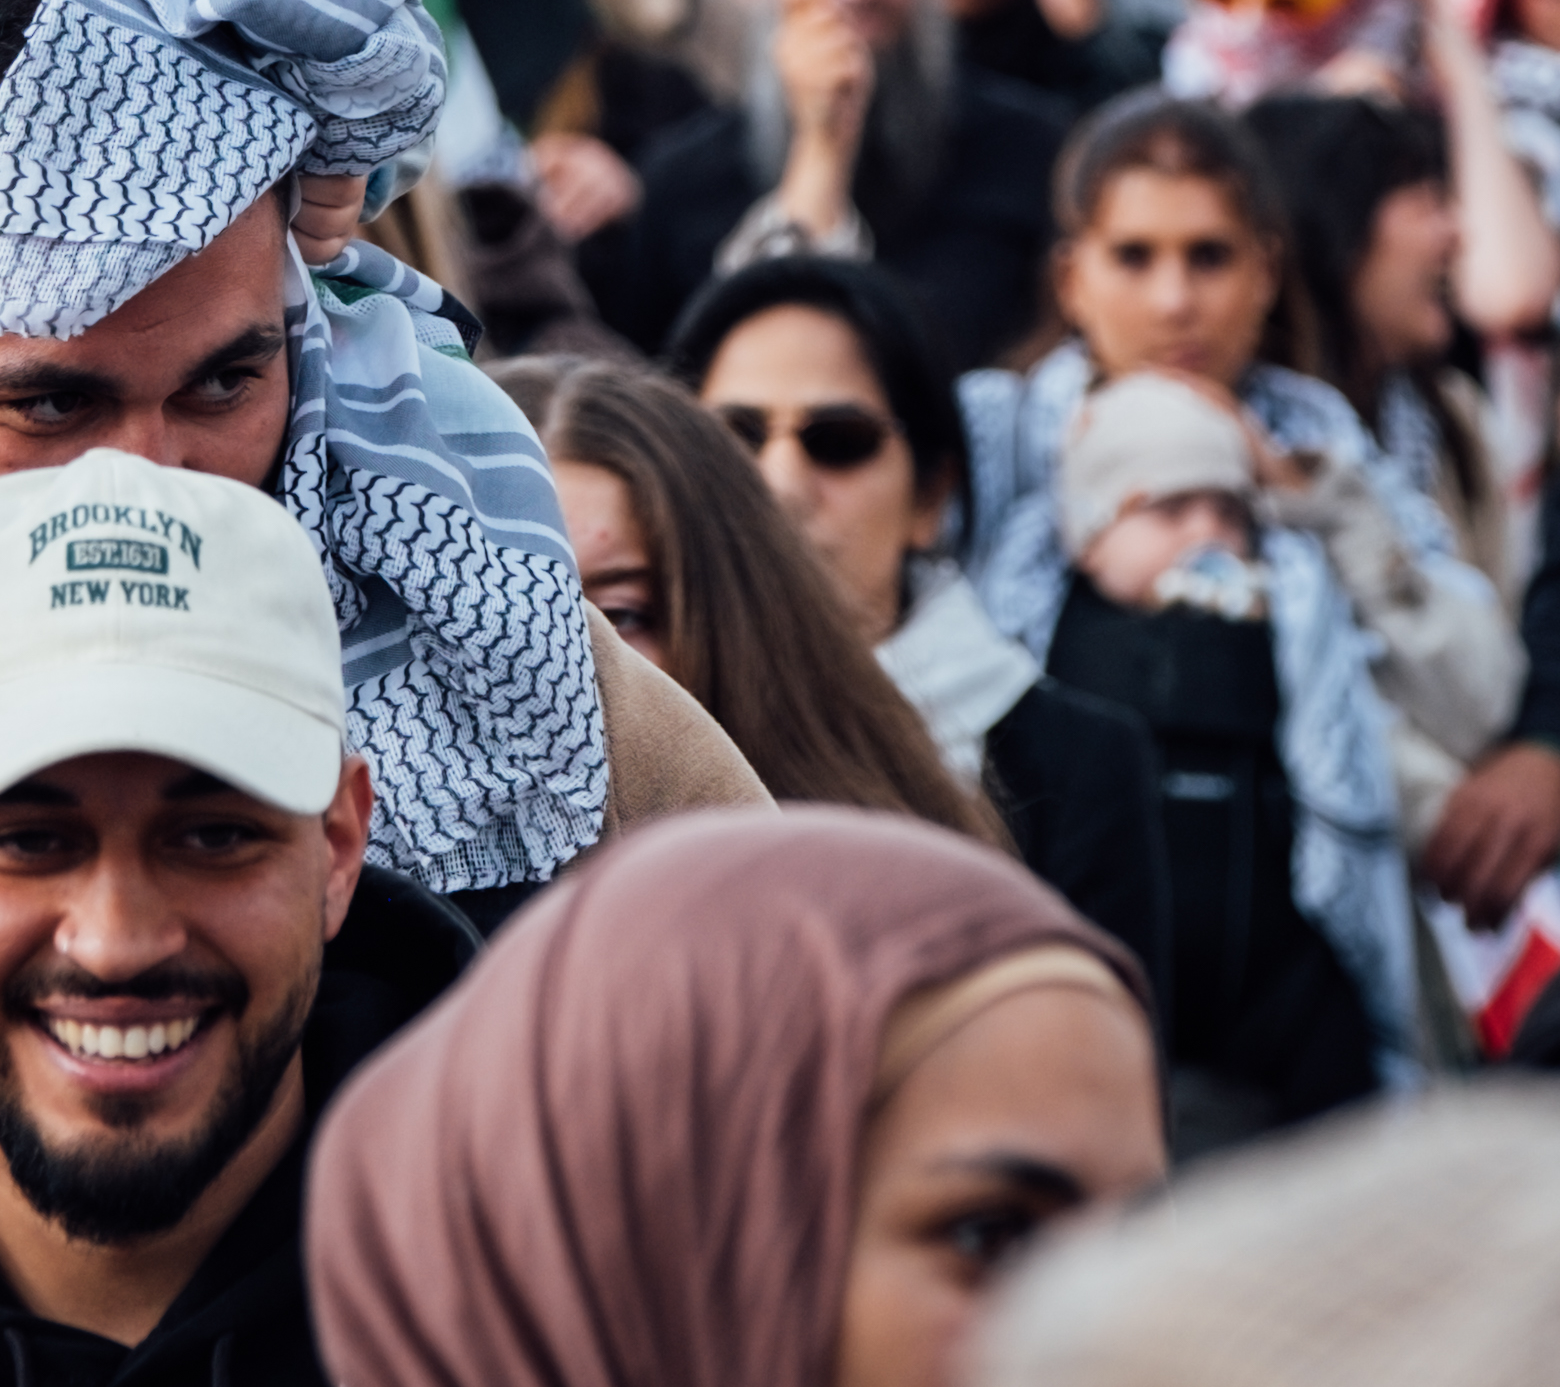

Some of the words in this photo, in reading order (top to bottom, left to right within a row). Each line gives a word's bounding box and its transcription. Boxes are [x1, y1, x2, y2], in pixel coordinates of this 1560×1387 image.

[28, 504, 202, 571] BROOKLYN
[50, 580, 110, 610] NEW
[119, 580, 190, 611] YORK
